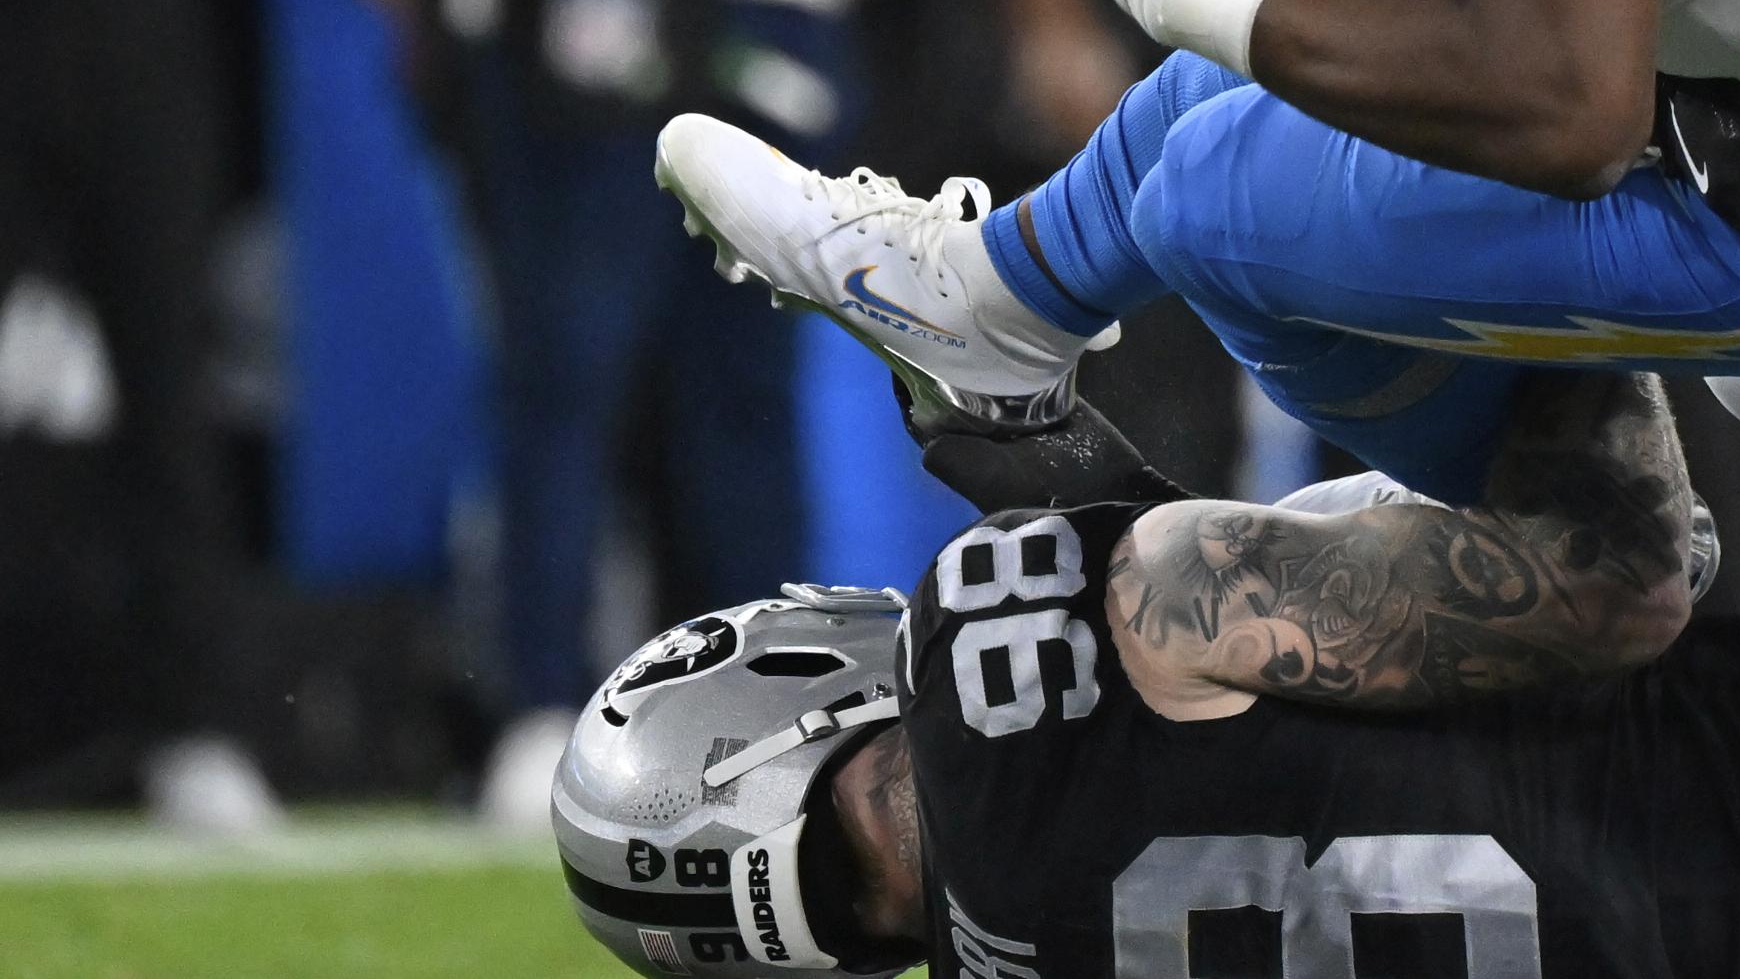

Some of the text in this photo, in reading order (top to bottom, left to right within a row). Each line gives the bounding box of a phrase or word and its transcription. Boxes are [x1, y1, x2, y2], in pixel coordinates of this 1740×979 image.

[911, 328, 967, 350] ZOOM
[936, 516, 1100, 739] 98
[634, 847, 651, 877] AL
[747, 848, 791, 962] RAIDERS
[1112, 833, 1541, 979] 8
